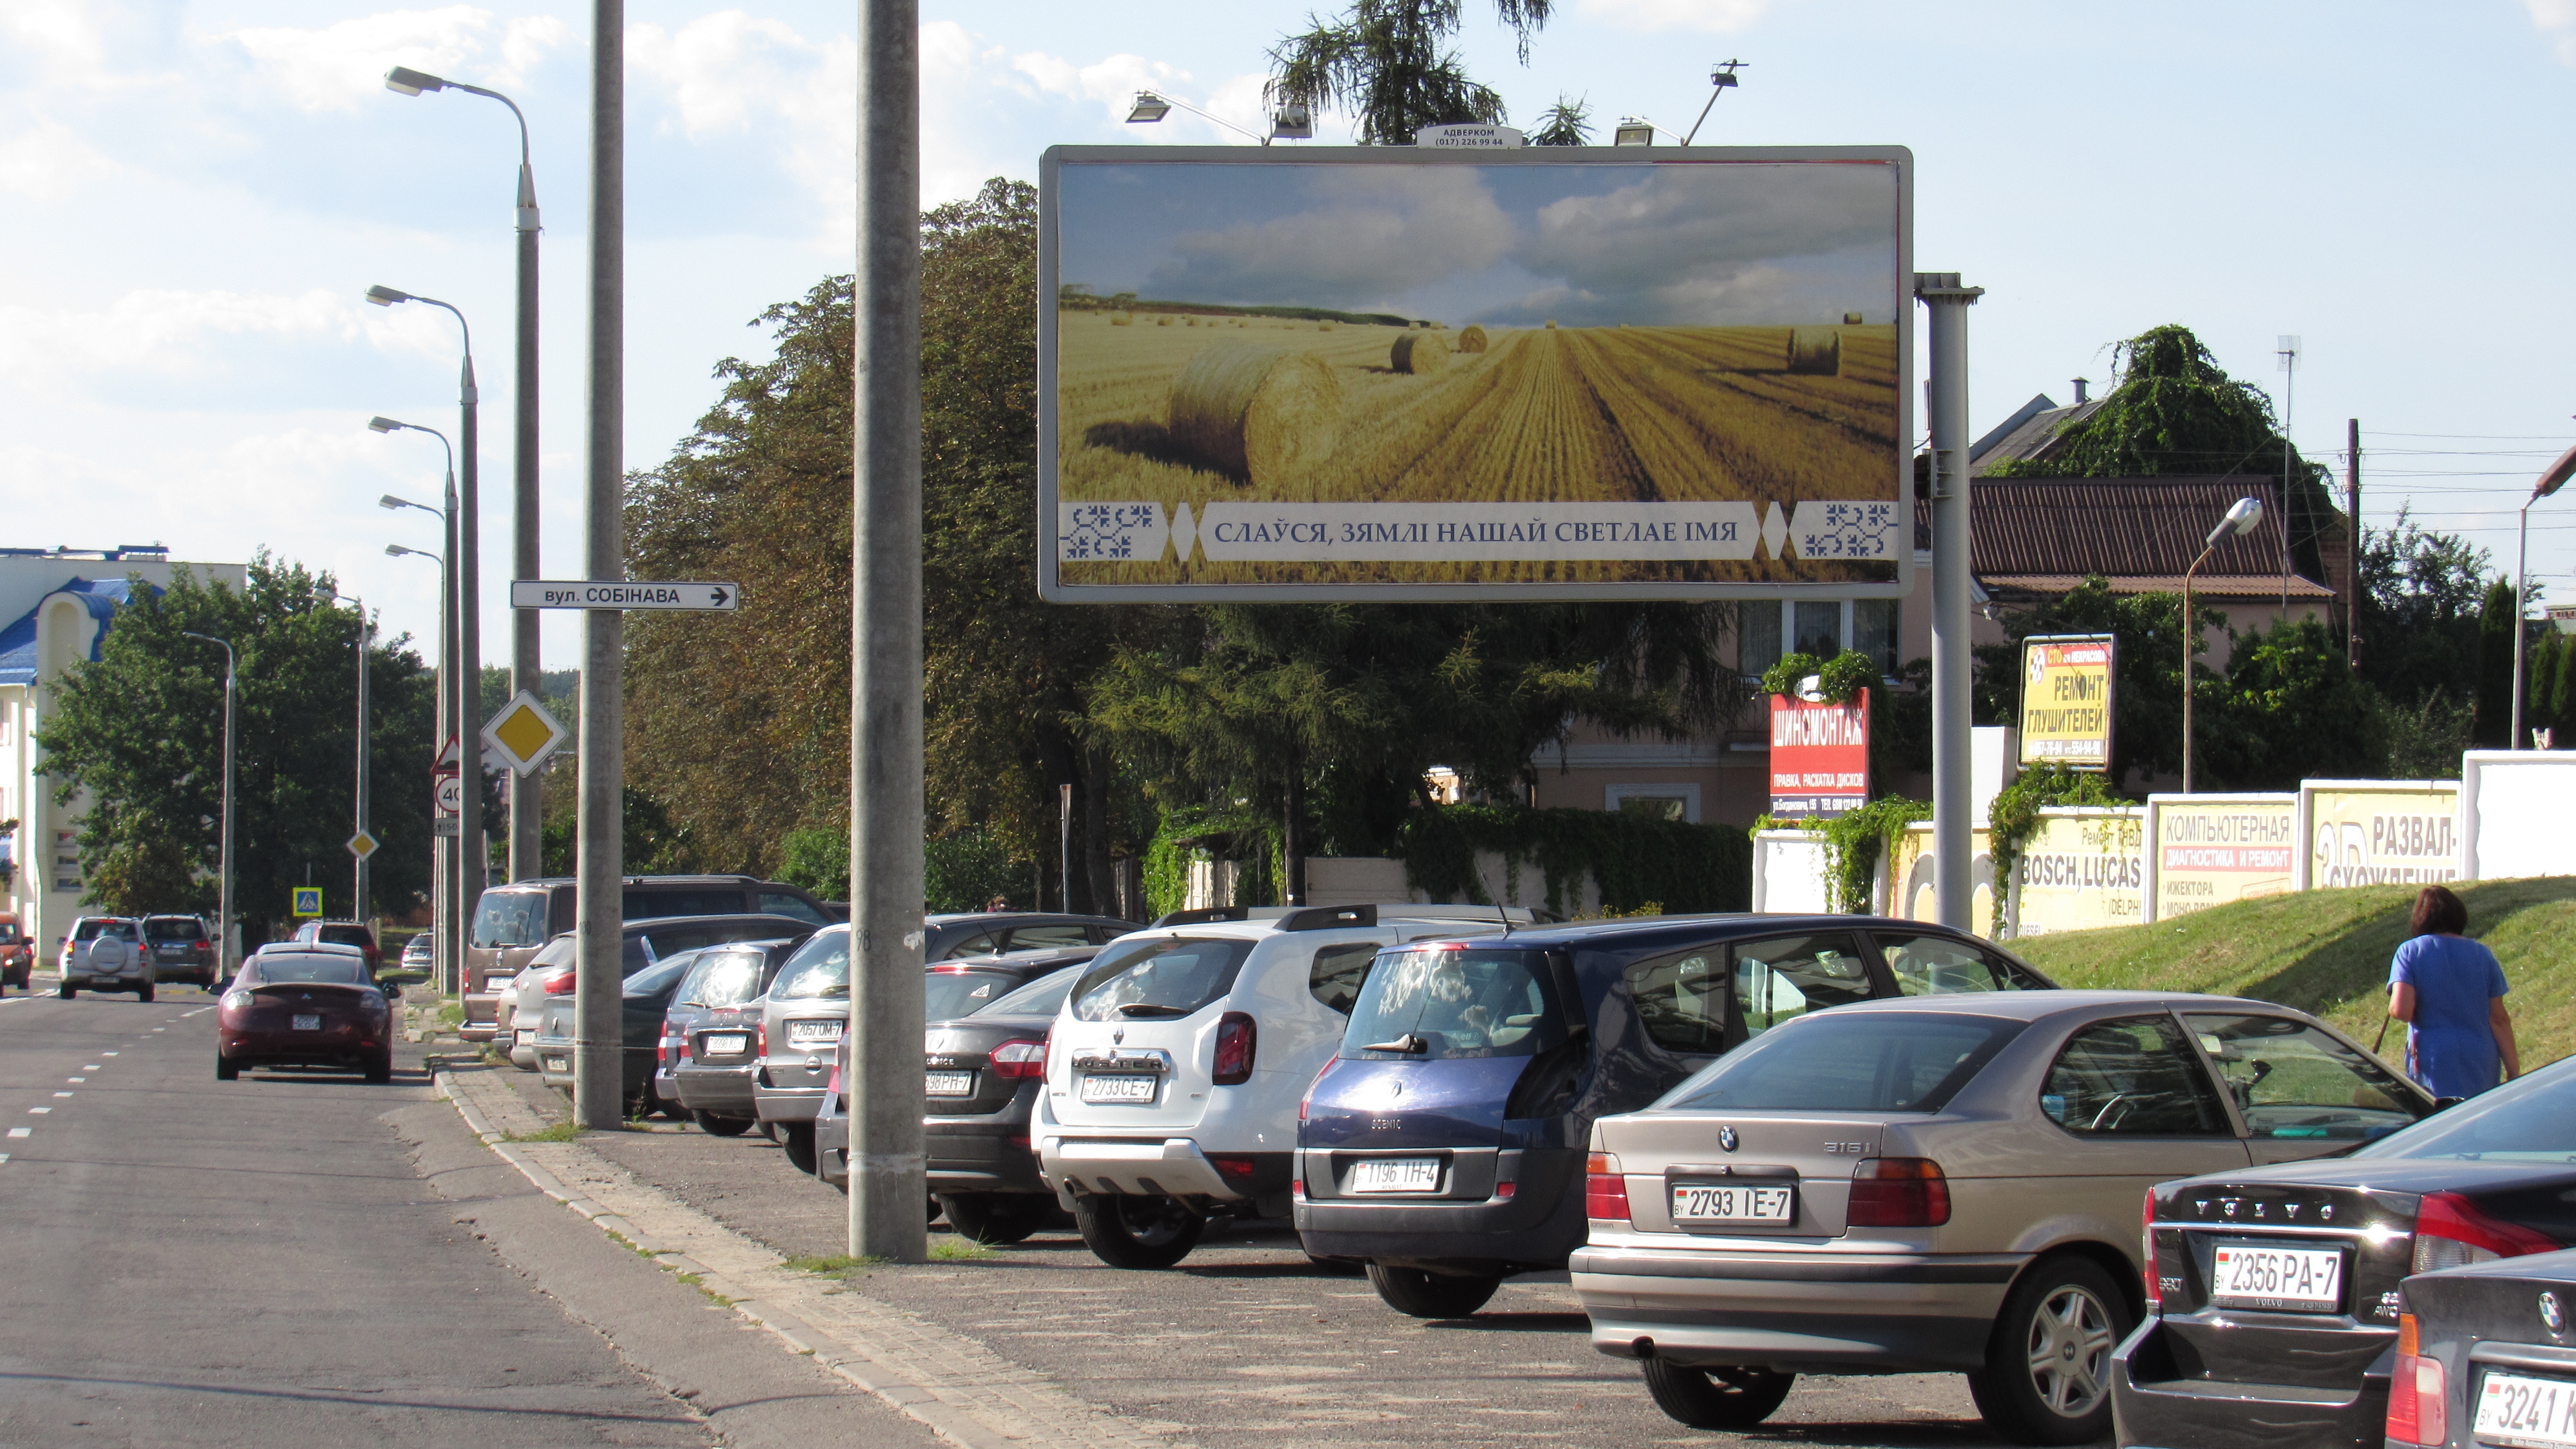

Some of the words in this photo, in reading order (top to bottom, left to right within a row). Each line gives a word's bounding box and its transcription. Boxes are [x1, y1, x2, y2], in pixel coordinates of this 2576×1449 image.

[1436, 138, 1459, 146] (017)
[1215, 518, 1334, 547] СЛАЎСЯ,
[1342, 523, 1428, 543] ЗЯМЛІ
[1437, 518, 1547, 542] НАШАЙ
[1555, 522, 1677, 542] СВЕТЛАЕ
[1684, 522, 1737, 542] ІМЯ
[545, 591, 580, 605] вул.
[586, 588, 680, 603] СОБІНАВА
[2047, 648, 2063, 664] СТО
[2071, 650, 2106, 664] НЕКРАСОВА
[2054, 675, 2104, 701] РЕМОНТ
[2027, 702, 2103, 733] ГЛУШИТЕЛЕЙ
[1773, 708, 1863, 747] ШИНОМОНТАЖ
[1773, 774, 1801, 789] ПРАВКА,
[1803, 773, 1836, 788] РАСКАТКА
[1836, 773, 1864, 790] ДИСКОВ
[2082, 827, 2114, 845] Ремонт
[2166, 815, 2289, 842] КОМПЬЮТЕРНАЯ
[2373, 816, 2456, 856] РАЗВАЛ-
[2166, 849, 2234, 869] ДИАГНОСТИКА
[2239, 850, 2246, 866] И
[2248, 850, 2289, 867] РЕМОНТ
[2167, 881, 2213, 896] ИЖЕКТОРА
[856, 929, 871, 952] 98
[798, 1022, 817, 1036] 2057
[819, 1022, 842, 1036] OM-7
[1092, 1077, 1119, 1096] 2733
[1121, 1078, 1154, 1096] CE-7
[1371, 1119, 1401, 1130] SCENIC
[1369, 1162, 1398, 1183] 1196
[1674, 1205, 1684, 1215] BY
[1689, 1190, 1733, 1215] 2793
[1744, 1190, 1788, 1216] IE-7
[2195, 1200, 2334, 1220] VOLVO
[2215, 1274, 2225, 1289] BY
[2231, 1253, 2279, 1292] 2356
[2282, 1254, 2337, 1295] PA-7
[2256, 1298, 2283, 1307] VOLVO
[2479, 1408, 2493, 1426] BY
[2498, 1384, 2557, 1433] 3241
